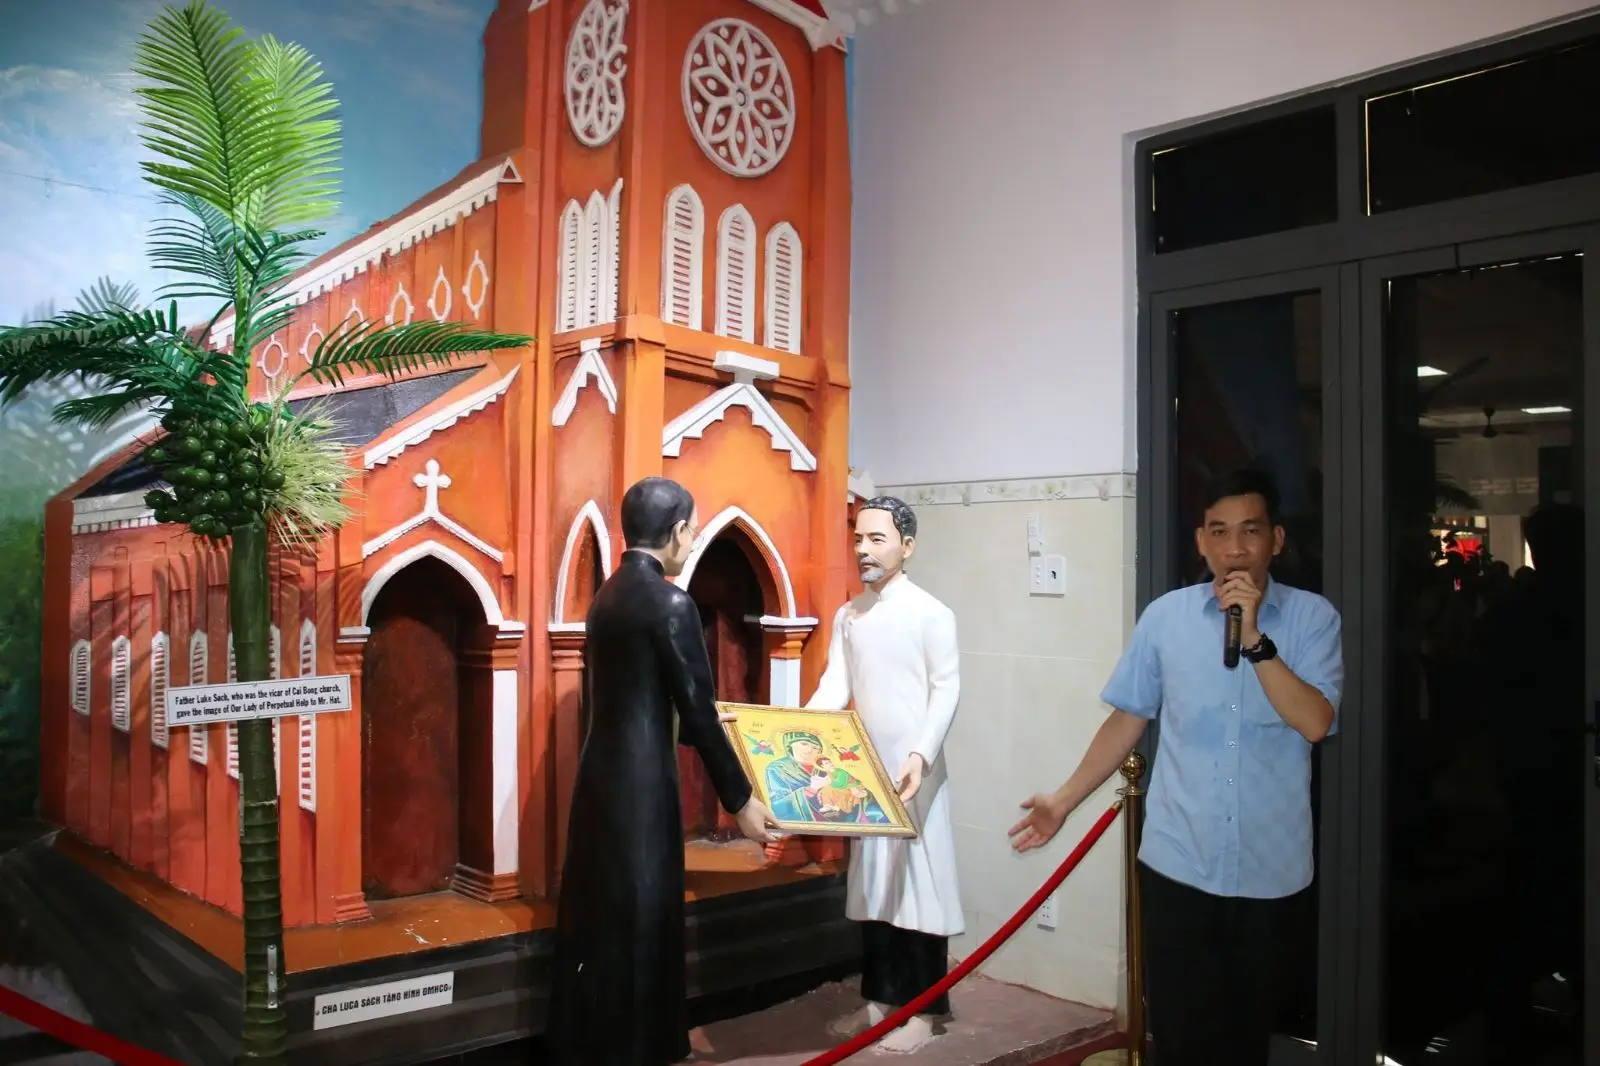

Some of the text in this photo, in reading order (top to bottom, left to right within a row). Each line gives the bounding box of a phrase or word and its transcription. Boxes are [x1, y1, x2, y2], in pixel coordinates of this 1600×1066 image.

[176, 696, 195, 705] Father
[197, 695, 211, 703] Luke
[258, 690, 267, 698] the
[285, 688, 290, 696] of
[292, 687, 301, 695] Cai
[176, 710, 190, 719] gave
[244, 703, 257, 712] Lady
[267, 700, 294, 709] Perpetual
[296, 699, 308, 707] Help
[322, 1004, 337, 1014] CHA
[340, 1000, 358, 1011] LUCA
